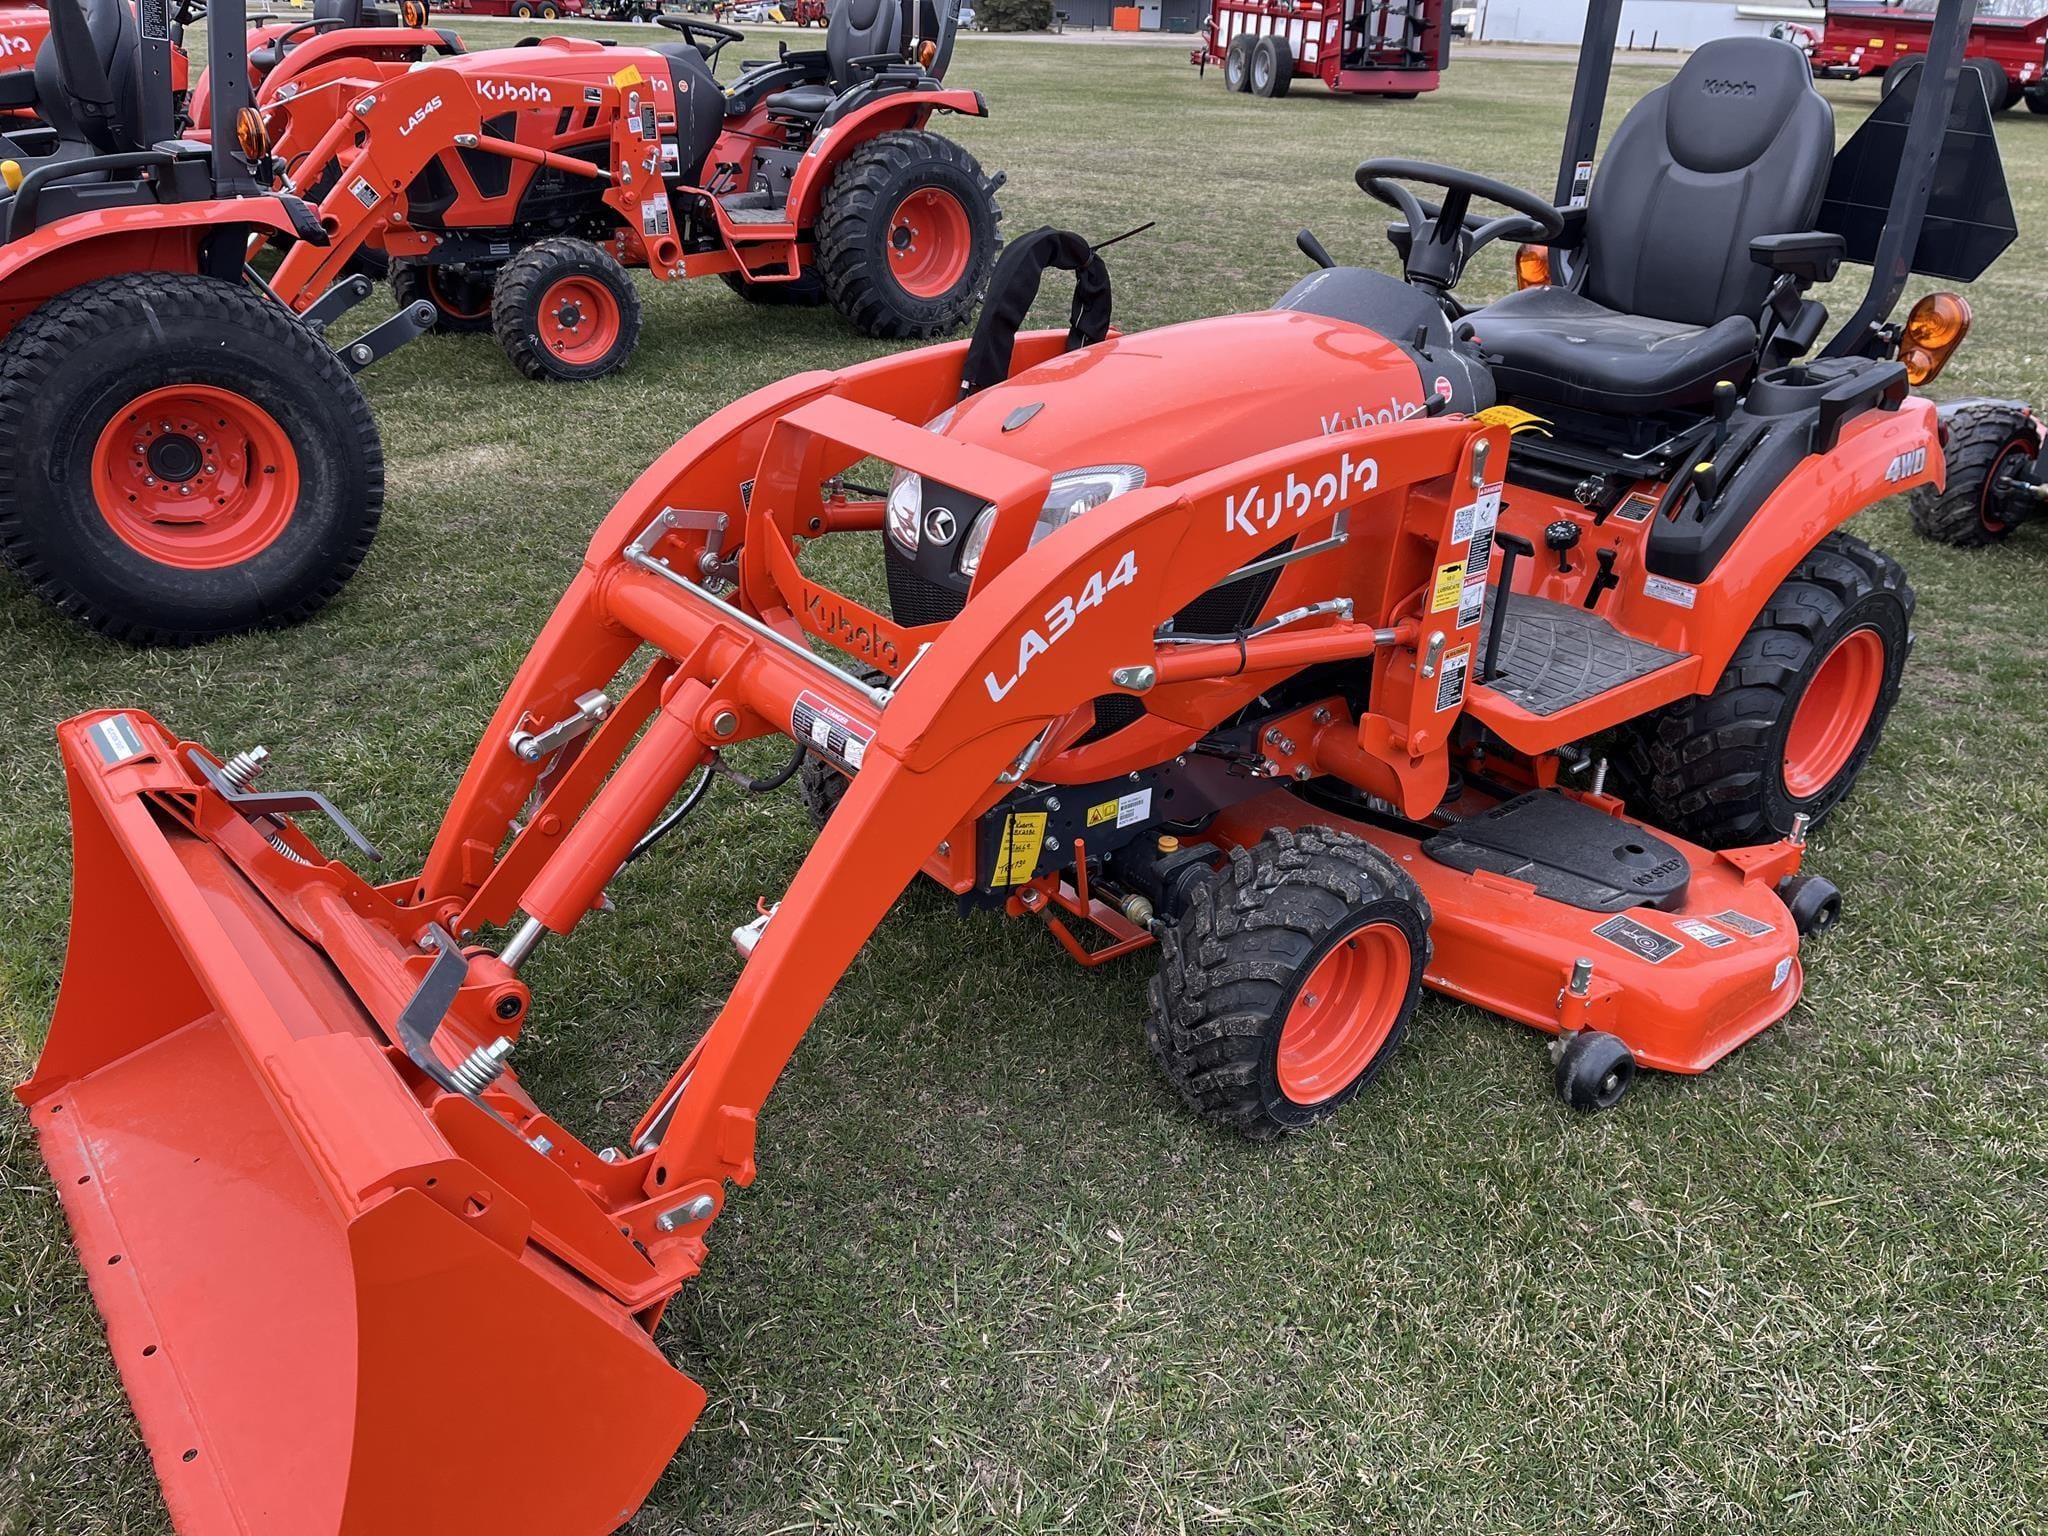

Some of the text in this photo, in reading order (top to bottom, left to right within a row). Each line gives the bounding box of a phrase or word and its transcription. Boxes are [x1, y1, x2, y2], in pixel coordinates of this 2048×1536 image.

[476, 79, 552, 103] Kubota
[1702, 78, 1758, 97] Kubota
[399, 95, 443, 137] LA545
[1884, 446, 1927, 484] 4WD
[1225, 452, 1379, 537] Kubota
[803, 588, 899, 670] Kubota
[984, 550, 1138, 703] LA344
[826, 707, 849, 725] DANGER
[1632, 857, 1684, 889] NO STEP
